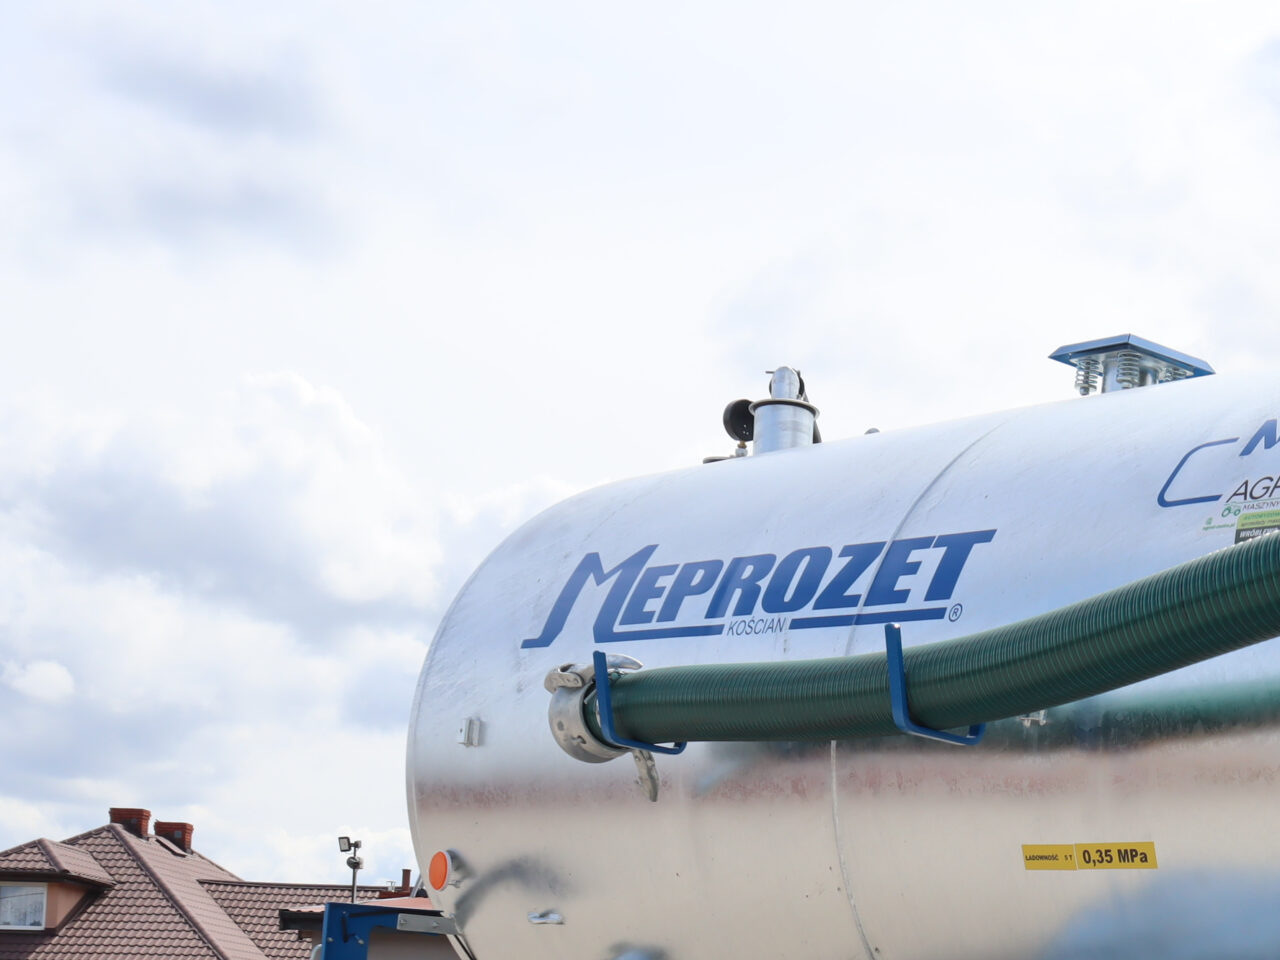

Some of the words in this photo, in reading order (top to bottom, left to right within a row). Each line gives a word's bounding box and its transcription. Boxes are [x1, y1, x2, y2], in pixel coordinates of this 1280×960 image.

[1242, 500, 1280, 511] MASZYNY
[520, 528, 998, 649] MEPROZET
[725, 616, 789, 637] KOŚCIAN
[1082, 849, 1113, 867] 0,35
[1117, 848, 1149, 864] MPa
